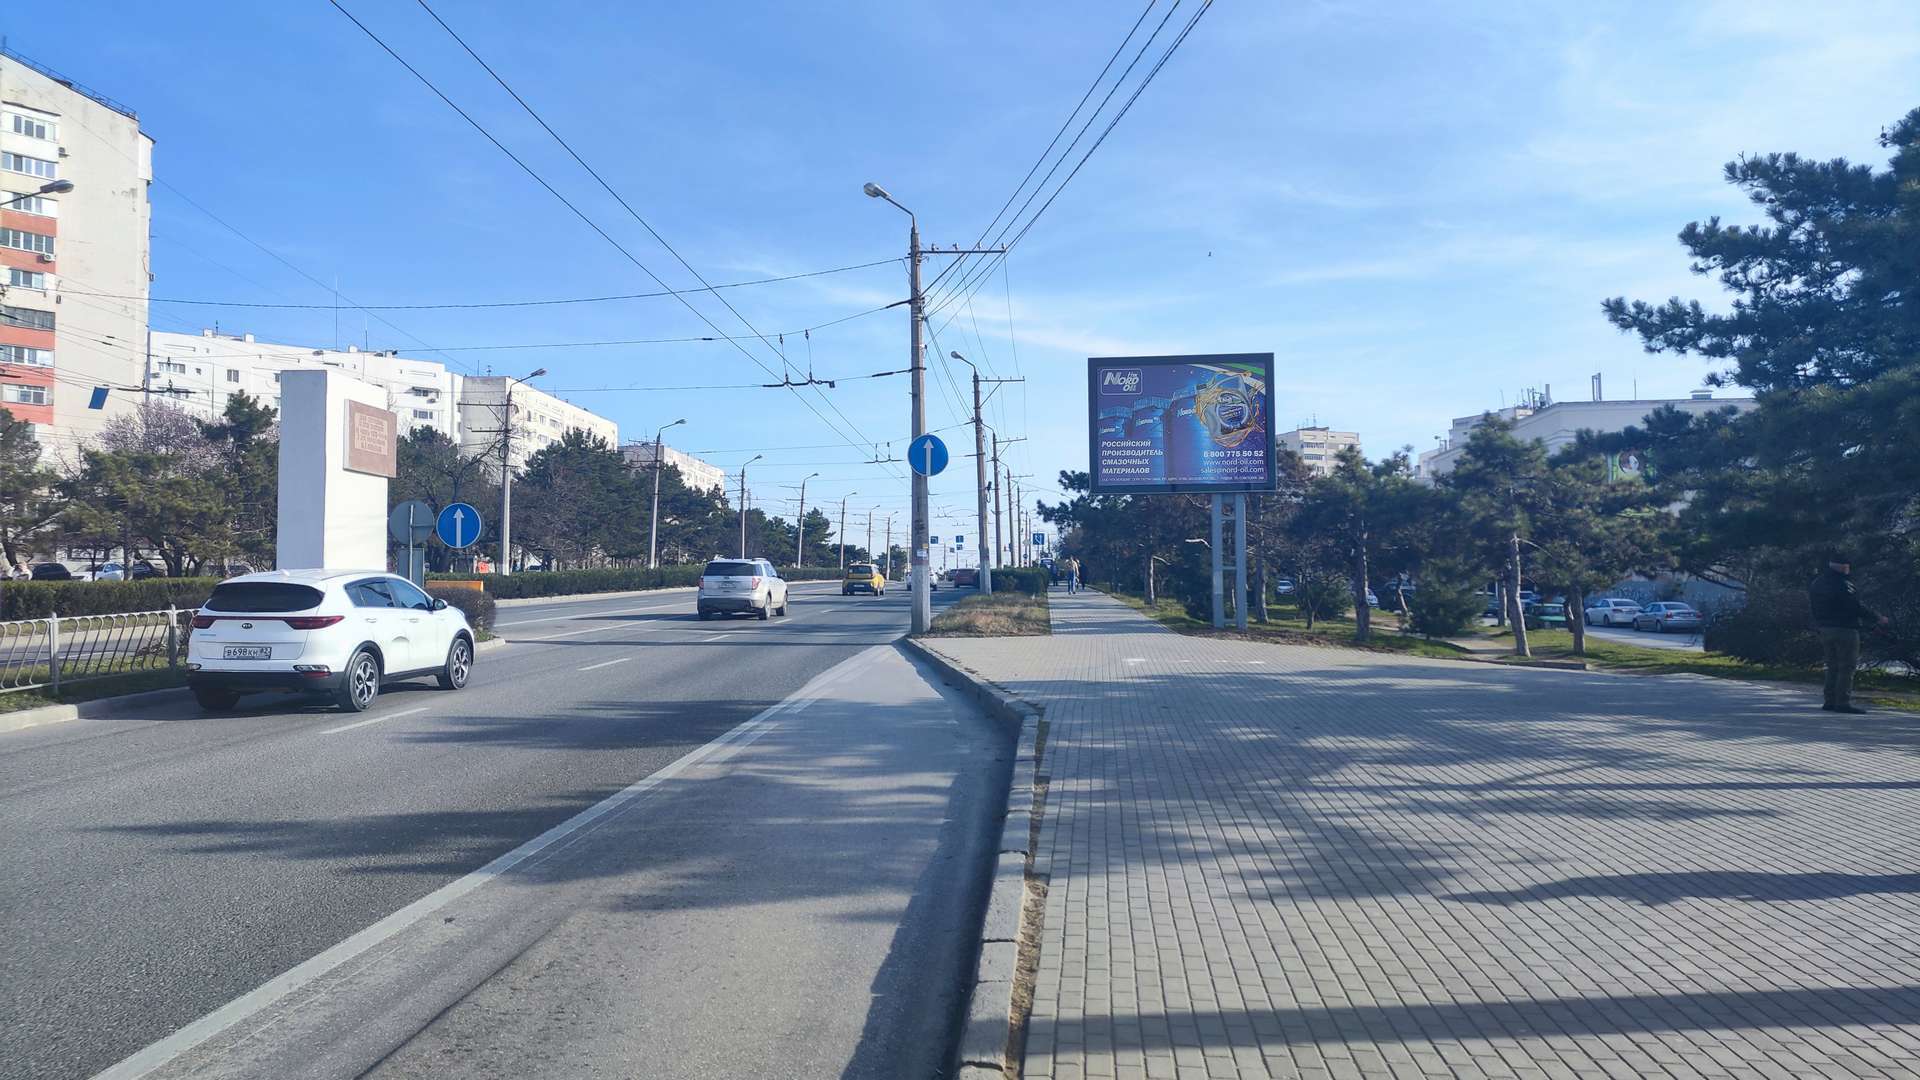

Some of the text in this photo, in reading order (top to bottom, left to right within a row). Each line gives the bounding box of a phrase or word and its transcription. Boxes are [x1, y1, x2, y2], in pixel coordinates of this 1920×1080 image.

[1101, 439, 1151, 447] РОССИЙСКИЙ
[1101, 449, 1164, 457] ПРОИЗВОДИТЕЛЬ
[1102, 458, 1150, 466] СМАЗОЧНЫХ
[1204, 458, 1264, 466] www.nord-oil.com
[1201, 466, 1264, 474] sales@nord-oil.com
